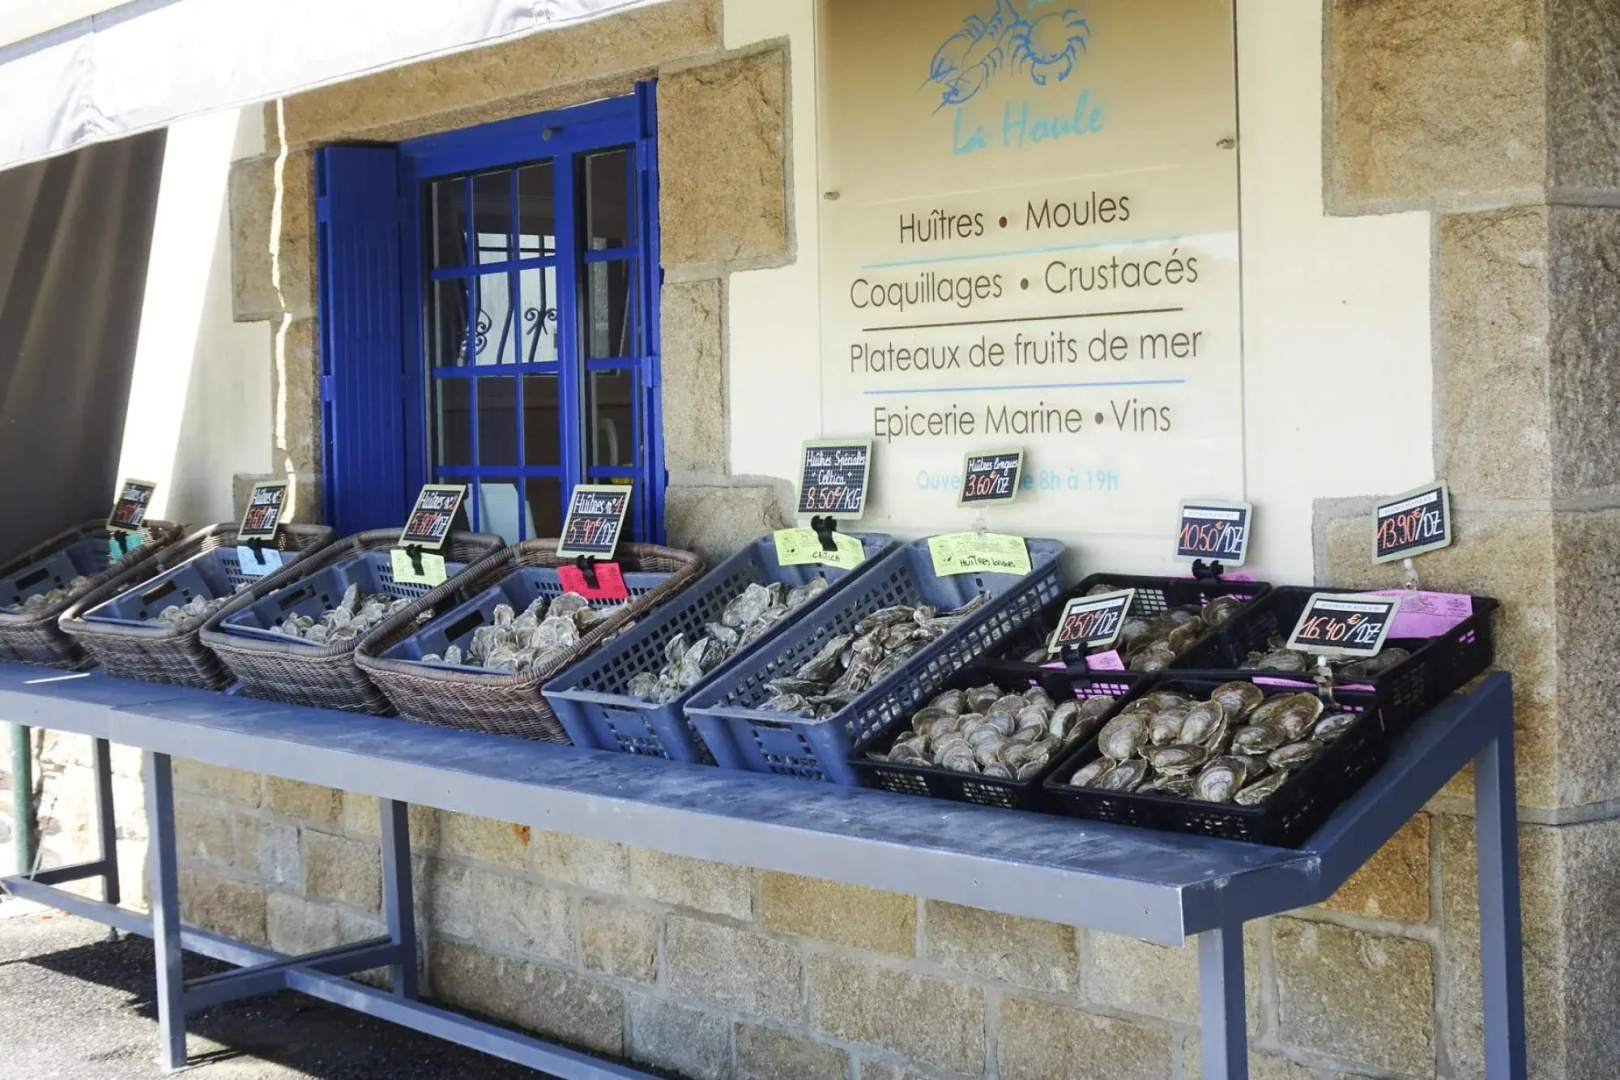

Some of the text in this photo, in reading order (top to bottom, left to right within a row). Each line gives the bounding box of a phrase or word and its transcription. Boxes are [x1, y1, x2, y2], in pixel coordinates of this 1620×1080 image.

[953, 89, 1103, 155] La Houle
[900, 192, 1130, 243] Huîtres Moules
[851, 248, 1198, 312] Coquillages Crustacés
[851, 329, 1202, 372] Plateaux de fruits de mer
[874, 399, 1170, 442] Epicerie Marine Vins
[1040, 467, 1061, 490] 8h
[1066, 469, 1079, 490] à
[1085, 468, 1119, 490] 19h
